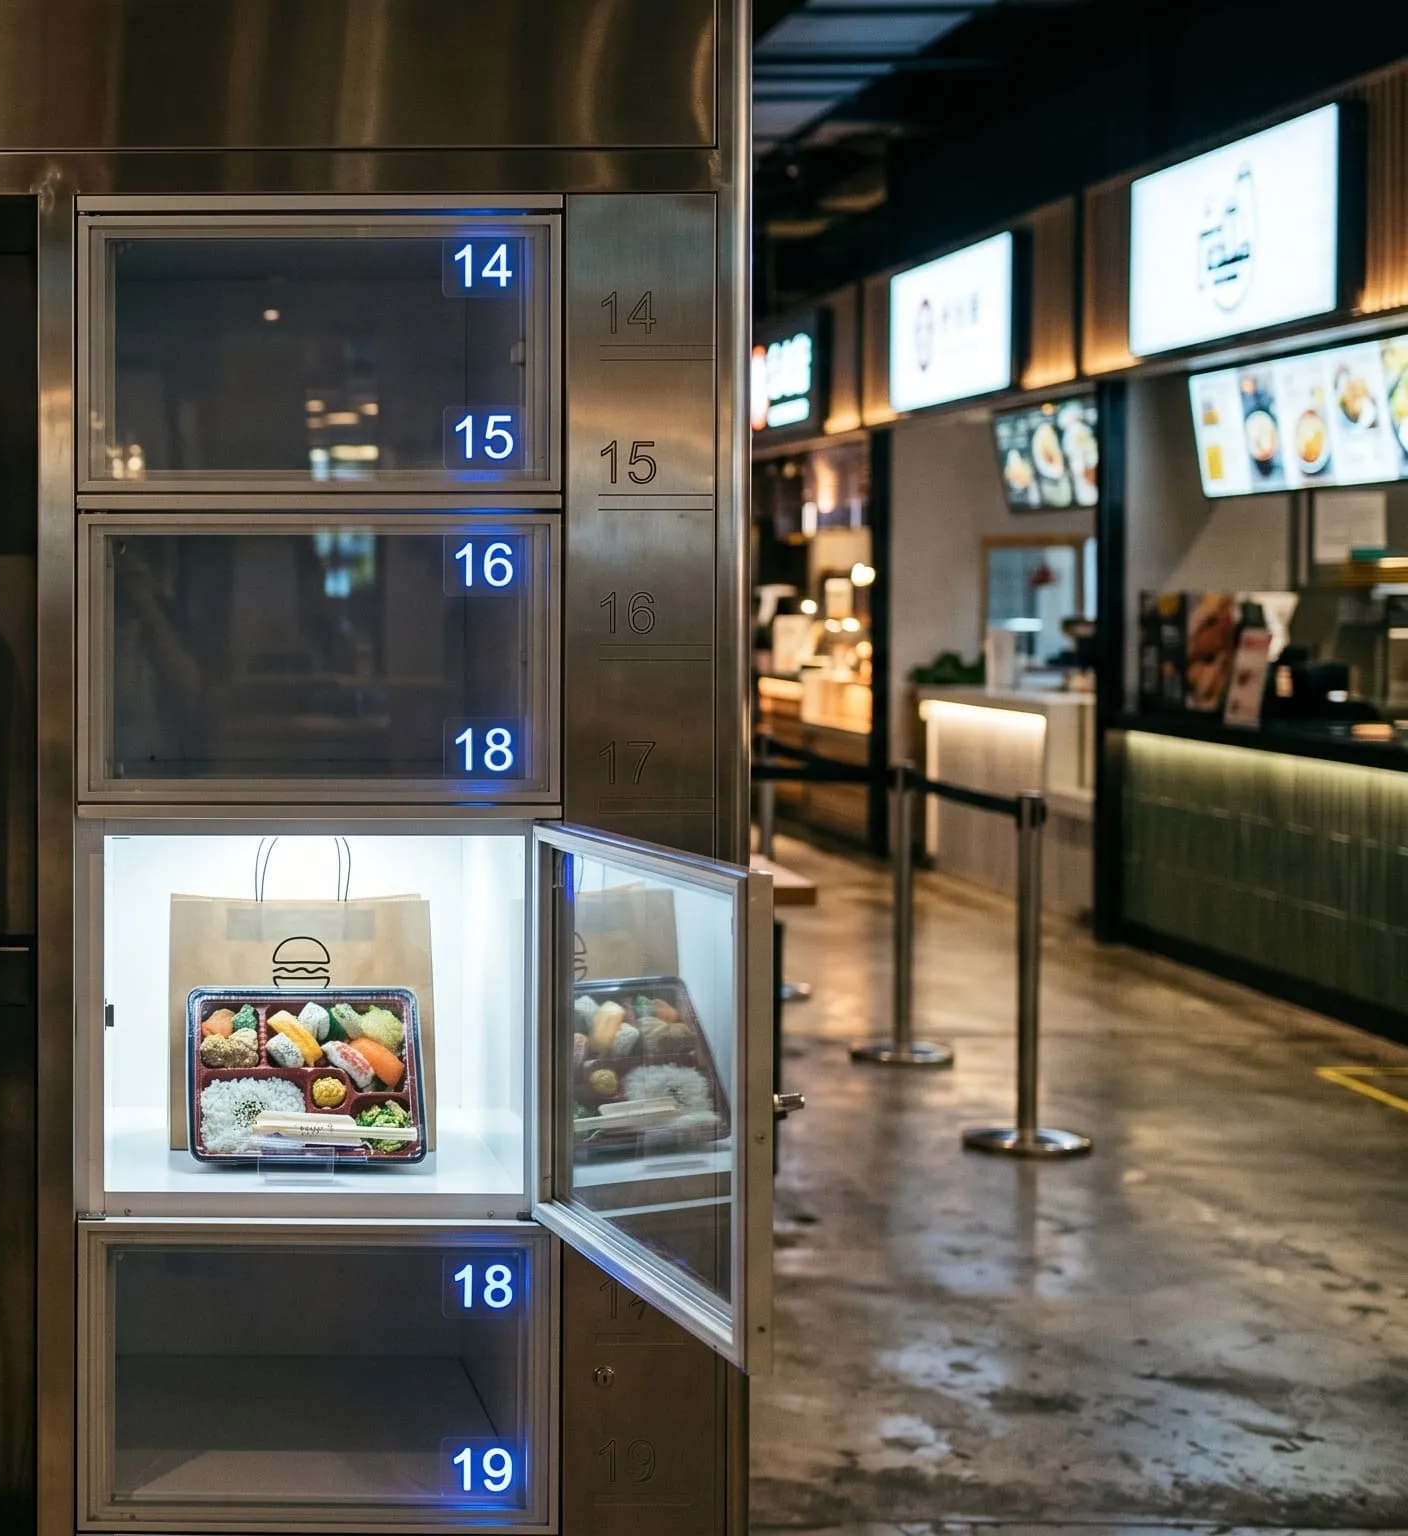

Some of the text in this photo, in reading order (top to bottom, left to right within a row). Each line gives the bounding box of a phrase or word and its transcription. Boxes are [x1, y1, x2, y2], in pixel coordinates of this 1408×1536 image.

[454, 244, 512, 287] 14
[600, 291, 657, 334] 14
[455, 415, 514, 459] 15
[600, 440, 657, 484] 15
[455, 542, 514, 587] 16
[599, 591, 656, 634] 16
[455, 728, 514, 771] 18
[599, 741, 656, 784] 17
[454, 1264, 513, 1308] 18
[453, 1447, 513, 1492] 19
[599, 1438, 656, 1483] 19
